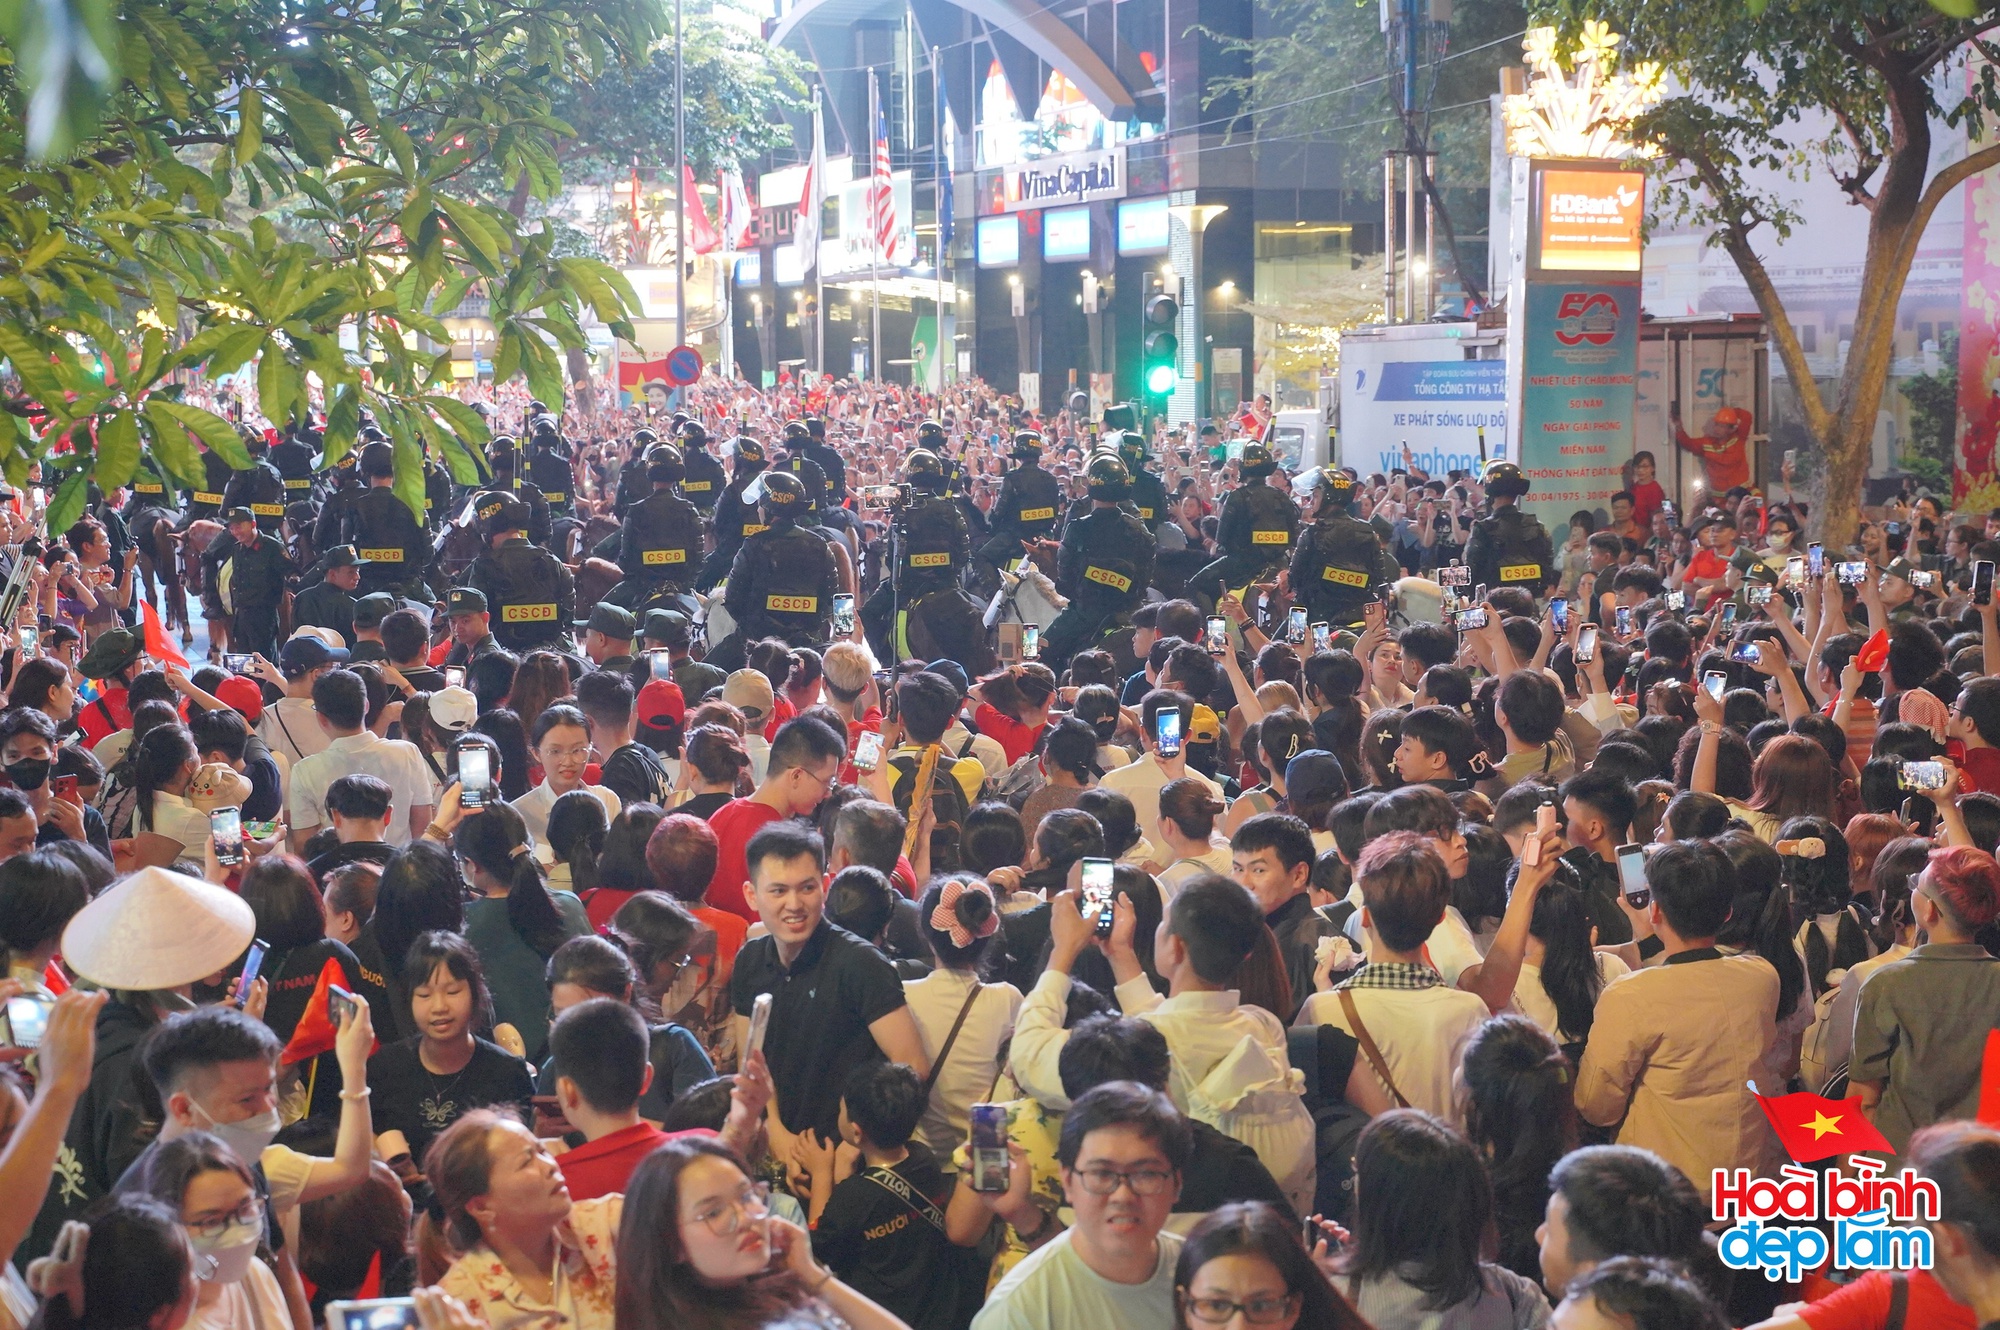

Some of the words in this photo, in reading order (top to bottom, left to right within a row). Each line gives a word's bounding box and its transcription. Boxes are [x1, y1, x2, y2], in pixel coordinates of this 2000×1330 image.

[1021, 153, 1119, 202] VinaCapital
[1550, 194, 1619, 215] HDBank
[1414, 379, 1438, 395] TỔNG
[1439, 381, 1463, 395] CÔNG
[1465, 384, 1477, 395] TY
[1479, 384, 1492, 397] HẠ
[1569, 400, 1580, 409] 50
[1582, 399, 1603, 408] NĂM
[1393, 413, 1405, 426] XE
[1408, 410, 1434, 426] PHÁT
[1436, 410, 1463, 427] SÓNG
[1466, 412, 1488, 427] LƯU
[1490, 410, 1505, 431] ĐỘ
[1543, 422, 1570, 432] NGÀY
[1586, 445, 1606, 454] NAM
[254, 506, 281, 514] CSCĐ
[1024, 510, 1051, 519] CSCĐ
[1256, 533, 1285, 542] CSCĐ
[365, 551, 400, 560] CSCĐ
[647, 552, 681, 562] CSCĐ
[915, 556, 947, 565] CSCĐ
[1090, 569, 1126, 587] CSCĐ
[1329, 570, 1363, 584] CSCĐ
[1505, 568, 1536, 579] CSCĐ
[771, 598, 811, 610] CSCĐ
[508, 607, 551, 619] CSCĐ
[864, 1214, 909, 1240] NGƯỜI
